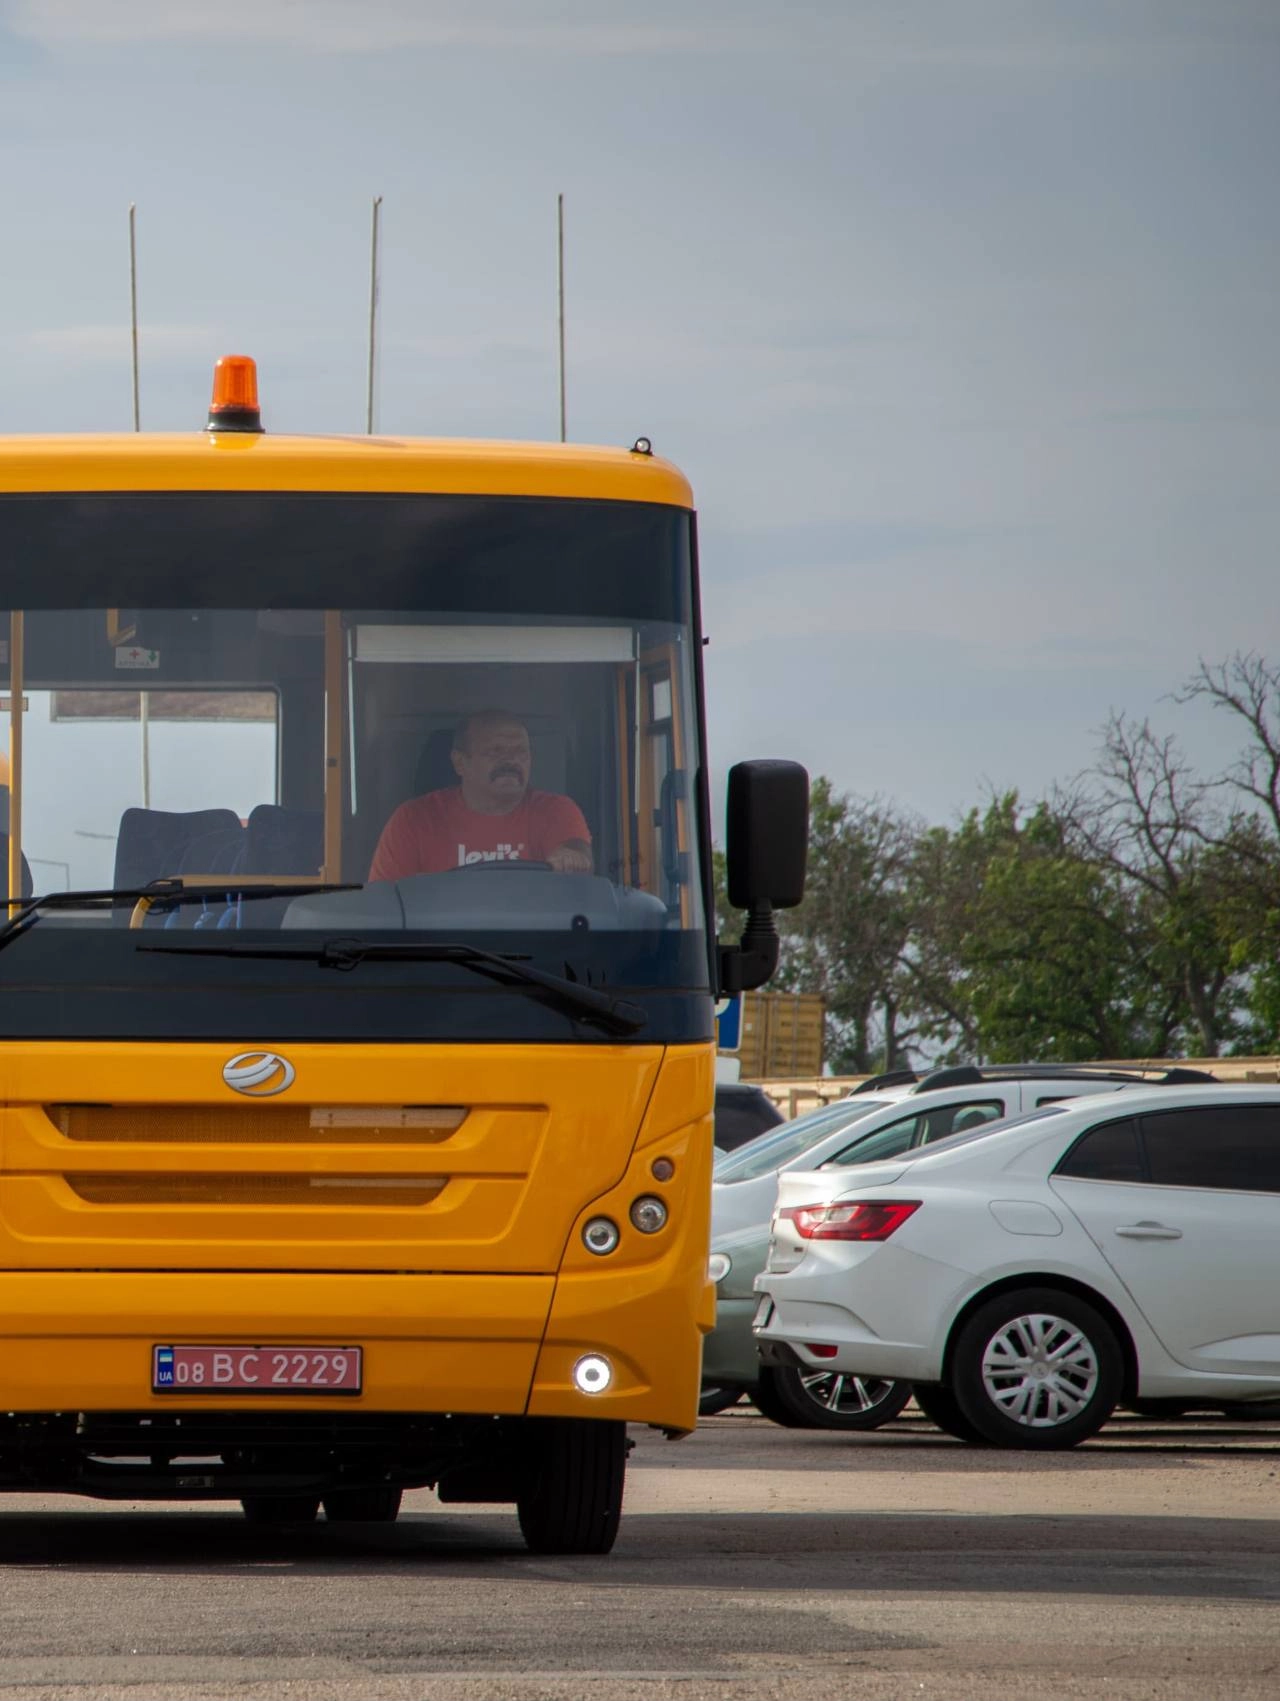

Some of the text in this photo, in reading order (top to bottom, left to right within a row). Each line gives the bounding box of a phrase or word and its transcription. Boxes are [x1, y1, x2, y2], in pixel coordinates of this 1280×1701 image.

[159, 1354, 349, 1384] UA 08 BC 2229
